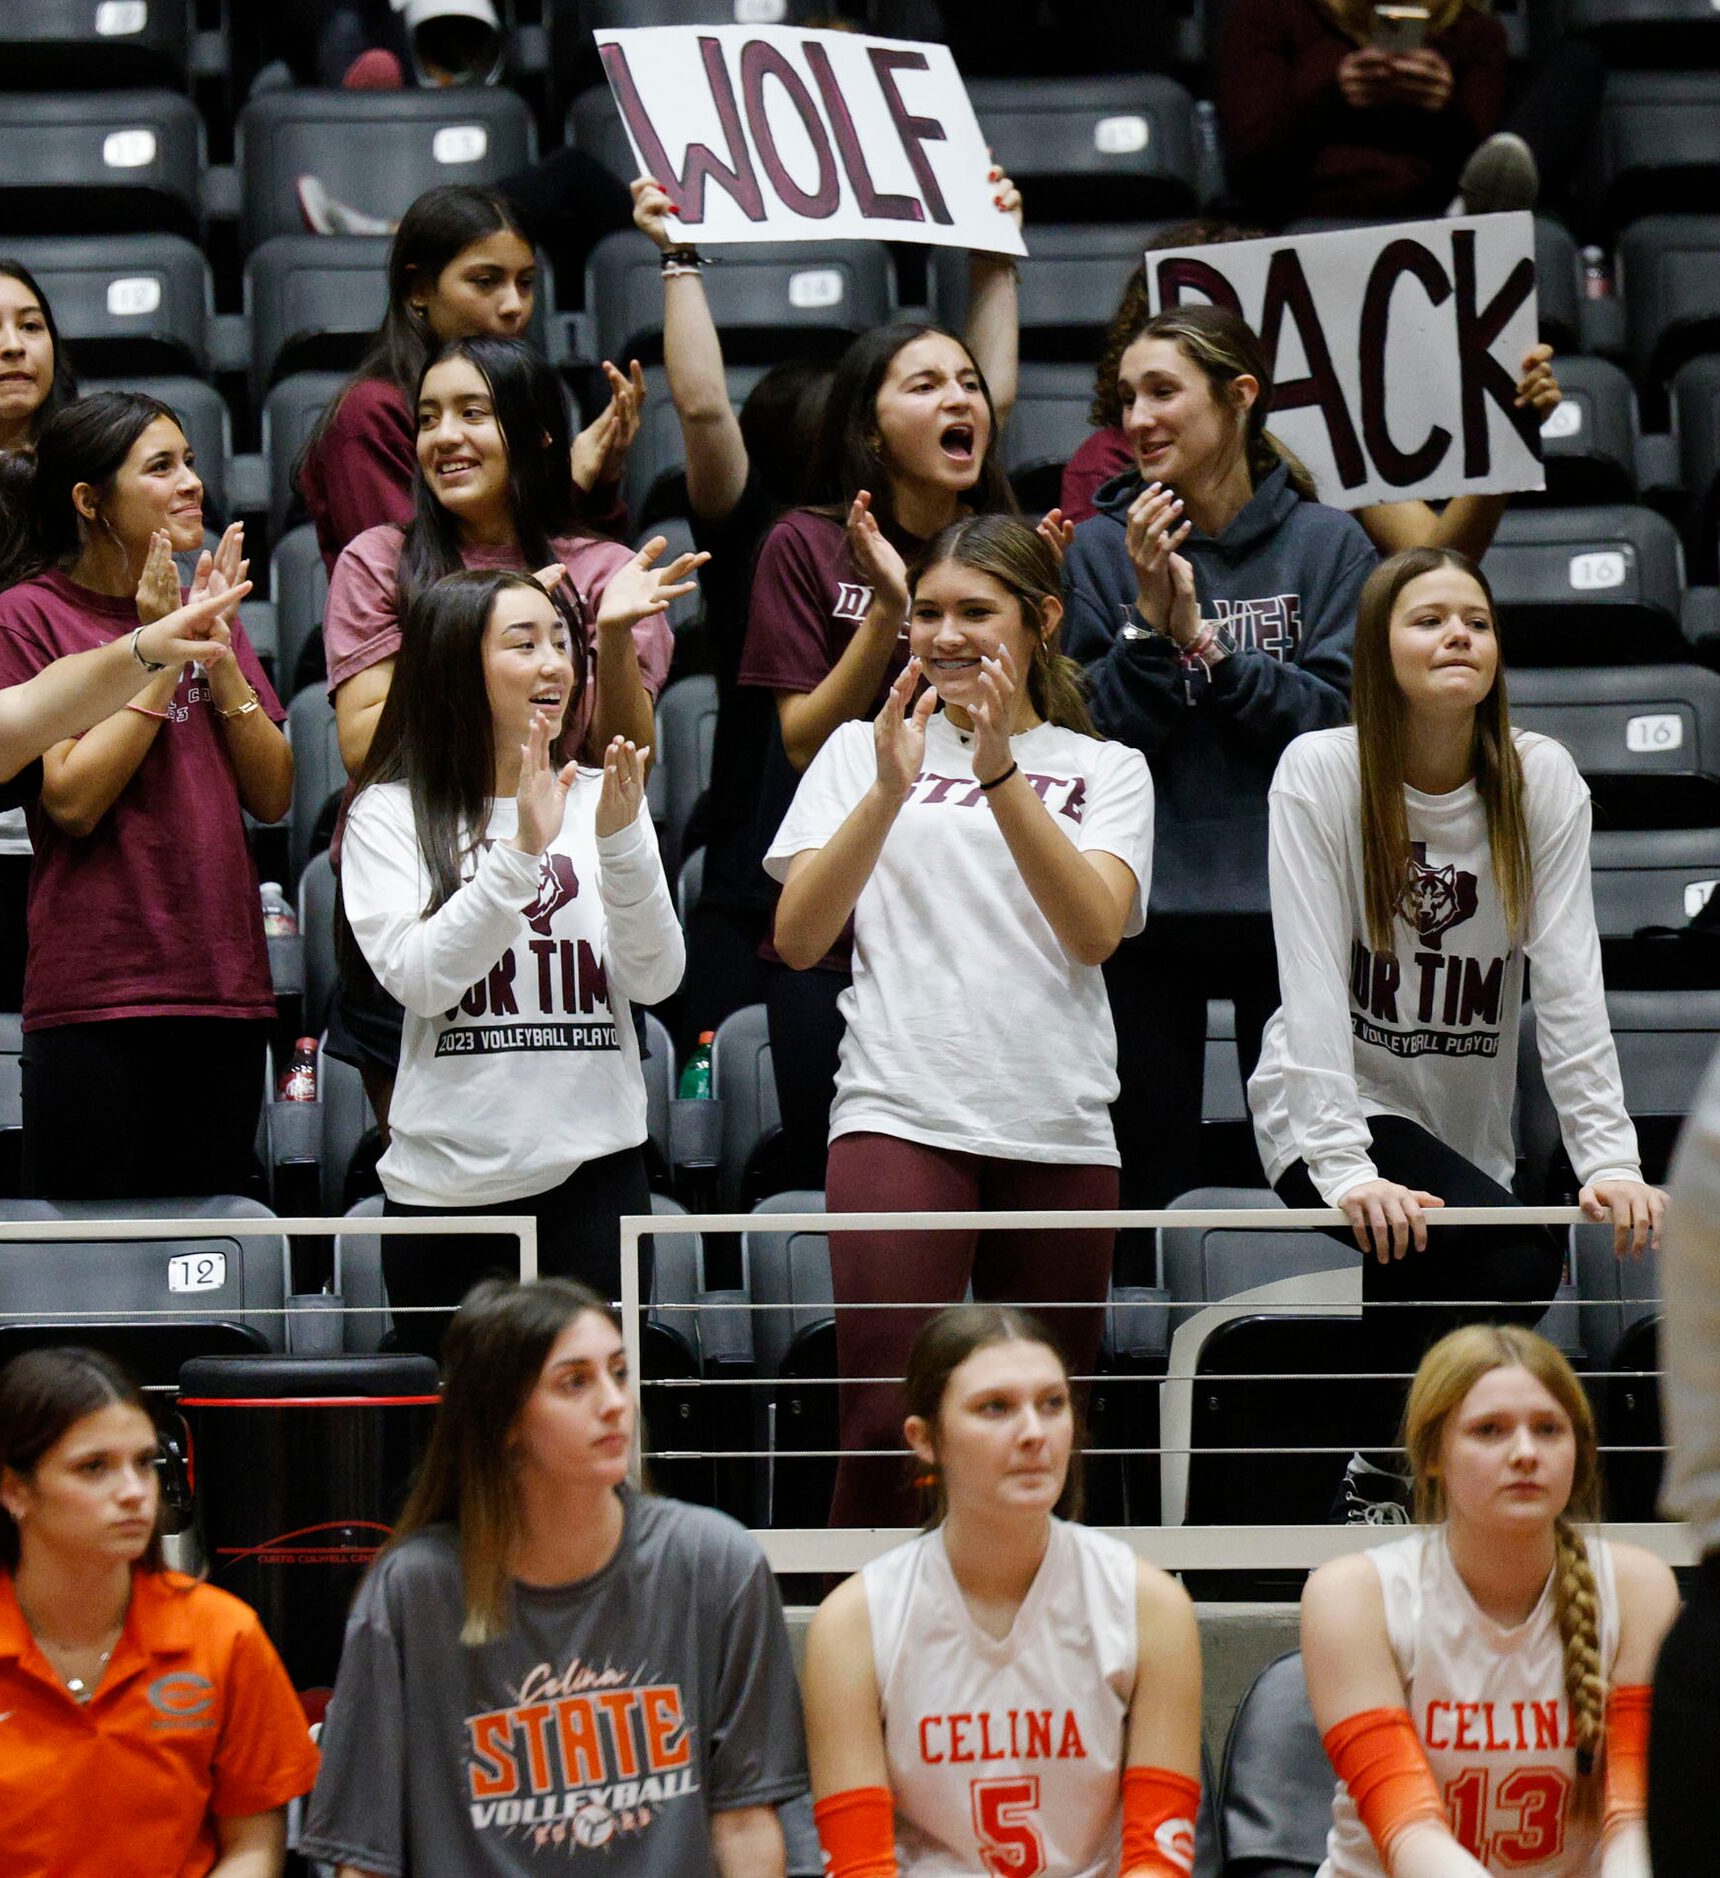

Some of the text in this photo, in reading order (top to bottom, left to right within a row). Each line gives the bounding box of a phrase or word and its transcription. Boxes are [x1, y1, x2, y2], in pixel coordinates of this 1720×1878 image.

[599, 37, 954, 225] WOLF
[1582, 560, 1615, 584] 16
[1639, 720, 1672, 745] 16
[445, 947, 520, 1022] UR
[1352, 938, 1400, 1024] UR
[438, 1032, 475, 1051] 2023
[480, 1027, 569, 1050] VOLLEYBALL
[1362, 1025, 1438, 1054] VOLLEYBALL
[182, 1260, 215, 1286] 12
[257, 1554, 295, 1564] CURTIS
[517, 1658, 628, 1706] Celina
[464, 1683, 691, 1801] STATE
[918, 1708, 1088, 1766] CELINA
[469, 1768, 701, 1831] VOLLEYBALL
[969, 1774, 1047, 1878] 5
[1444, 1765, 1572, 1871] 13
